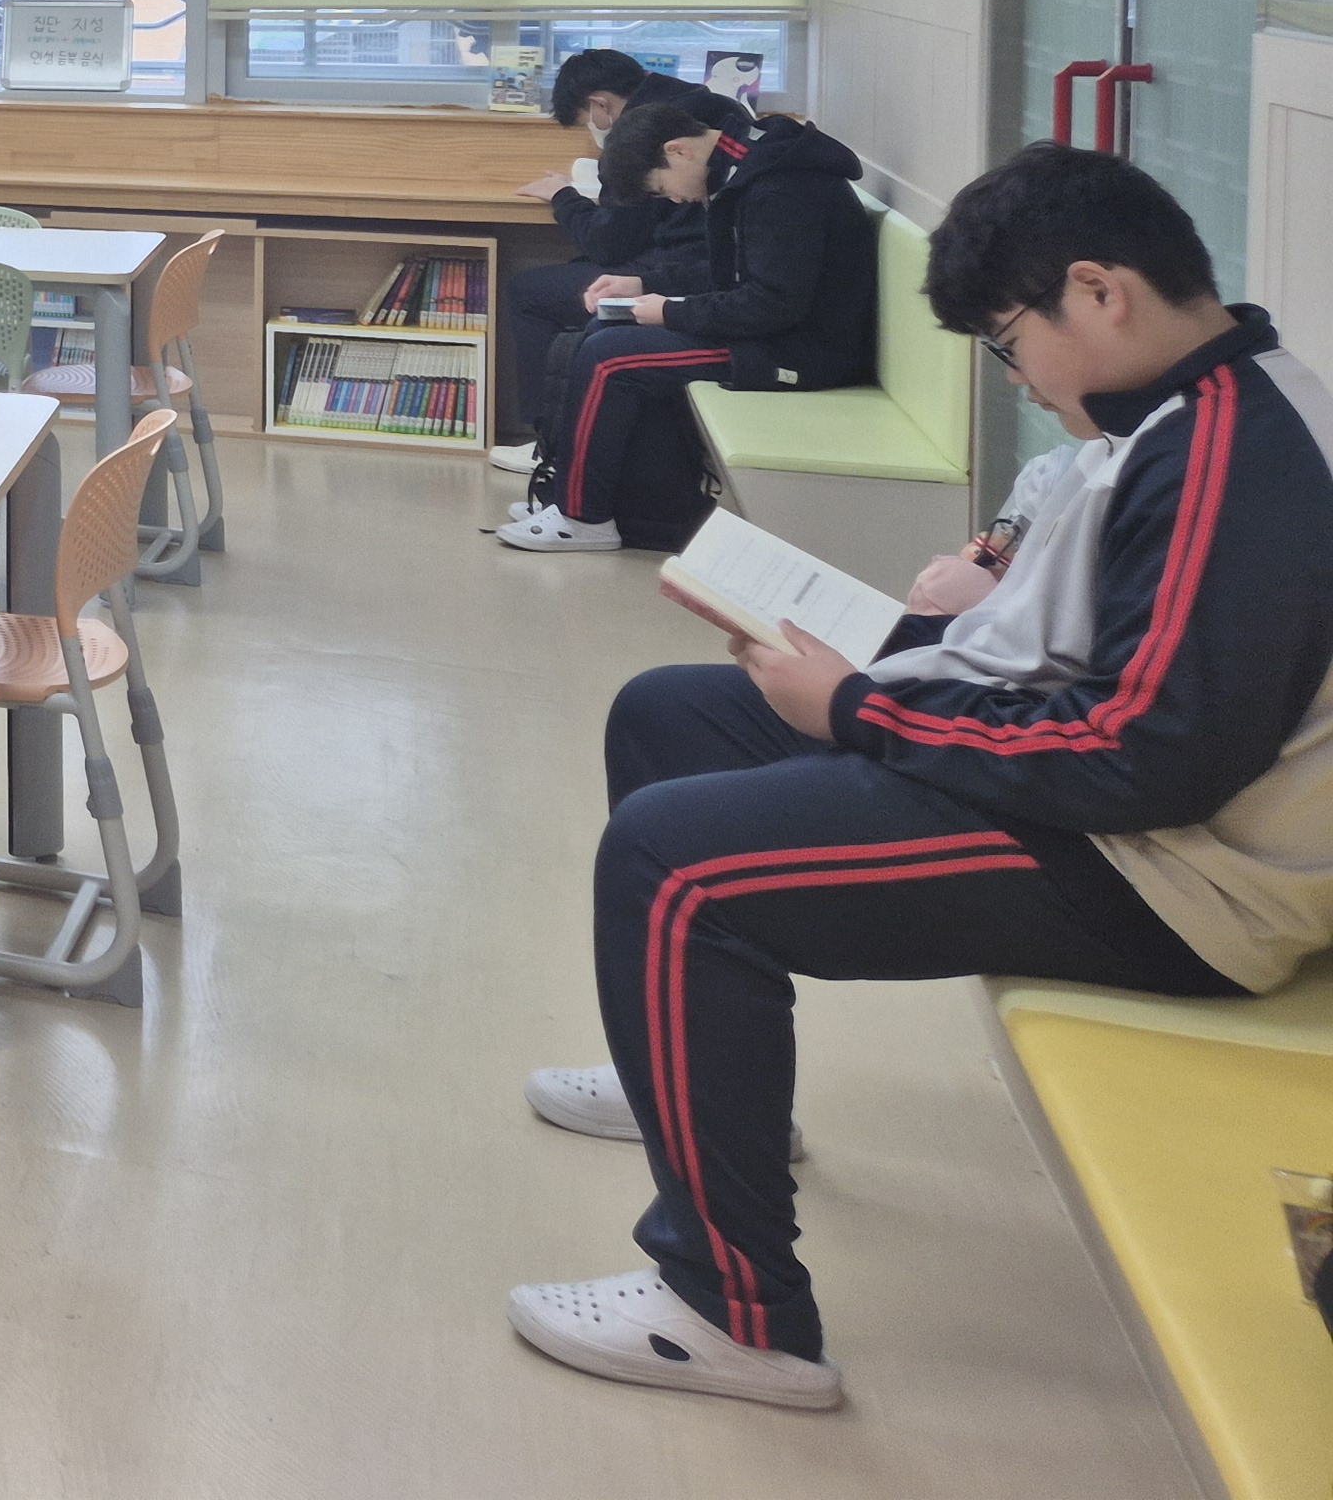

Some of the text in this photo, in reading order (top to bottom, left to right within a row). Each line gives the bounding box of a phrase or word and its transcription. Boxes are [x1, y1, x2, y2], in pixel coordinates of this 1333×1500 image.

[33, 16, 104, 34] 집단 지성
[30, 50, 54, 66] 인성
[81, 51, 104, 68] 음식
